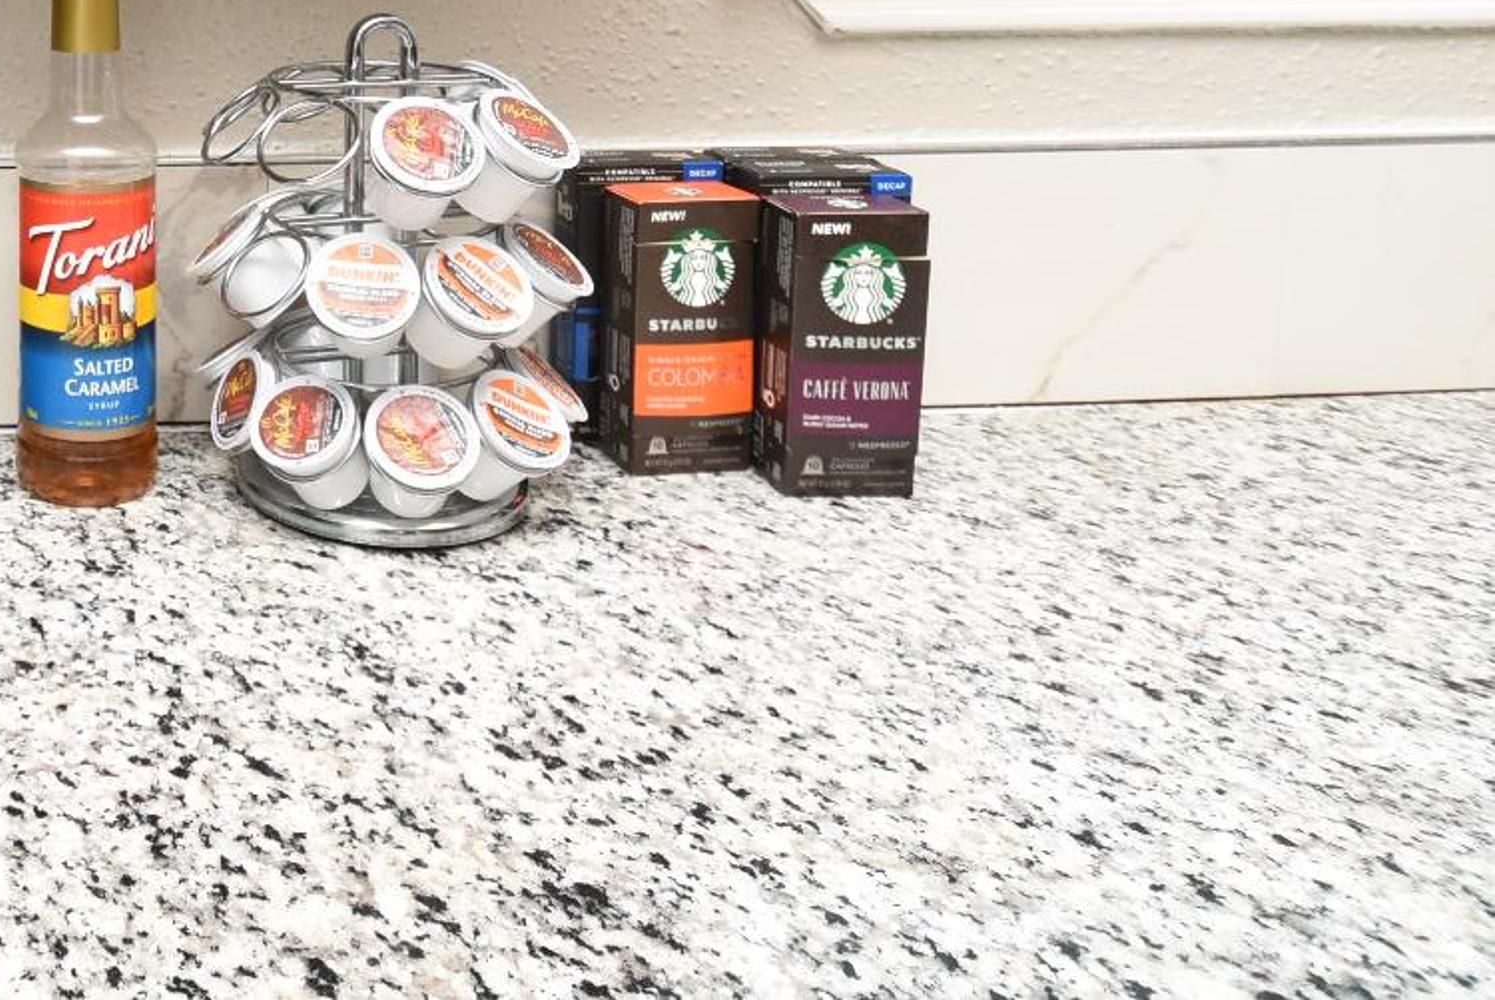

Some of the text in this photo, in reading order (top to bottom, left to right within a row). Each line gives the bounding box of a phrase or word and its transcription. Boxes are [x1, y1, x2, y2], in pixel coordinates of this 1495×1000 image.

[651, 210, 686, 223] NEW!
[811, 222, 852, 236] NEW!
[28, 203, 156, 296] Torani
[648, 317, 727, 332] STARBU
[805, 334, 917, 350] STARBUCKS
[74, 357, 134, 376] SALTED
[647, 366, 727, 388] COLOM
[64, 376, 140, 397] CARAMEL
[854, 380, 910, 401] VERONA
[88, 400, 120, 411] SYRUP
